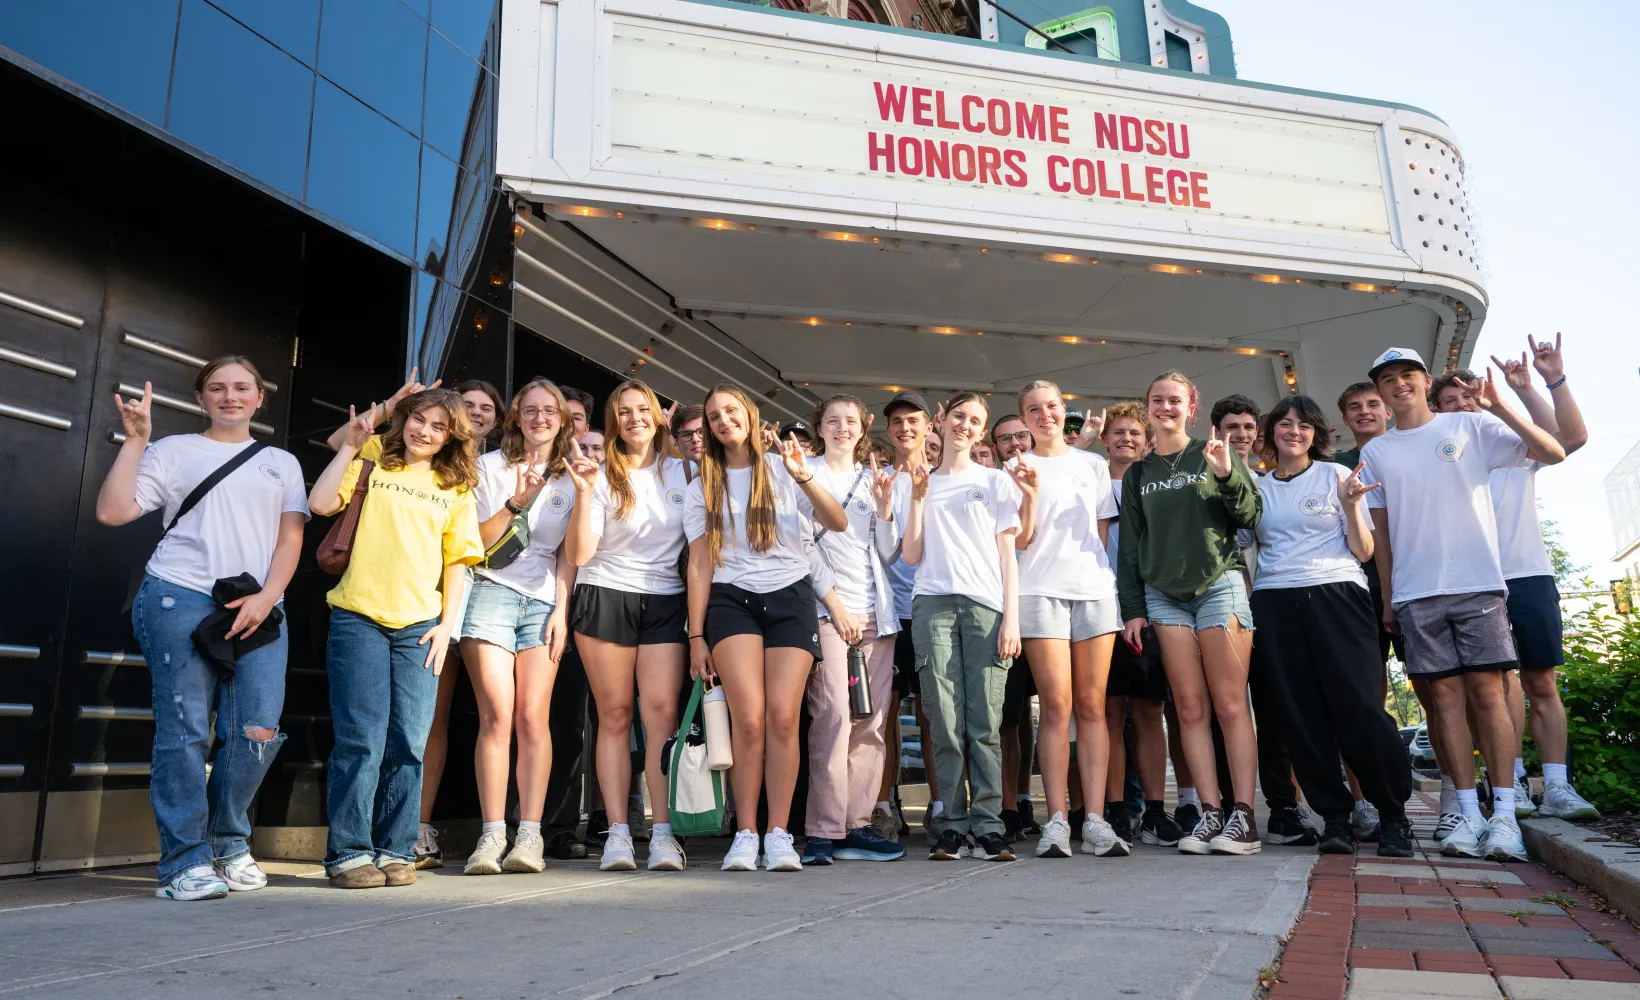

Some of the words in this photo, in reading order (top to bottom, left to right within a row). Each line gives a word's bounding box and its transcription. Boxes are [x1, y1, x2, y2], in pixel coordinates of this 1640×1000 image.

[873, 81, 1070, 144] WELCOME
[1094, 112, 1190, 159] NDSU
[868, 132, 1028, 187] HONORS
[1047, 155, 1211, 209] COLLEGE
[371, 479, 449, 509] HONORS
